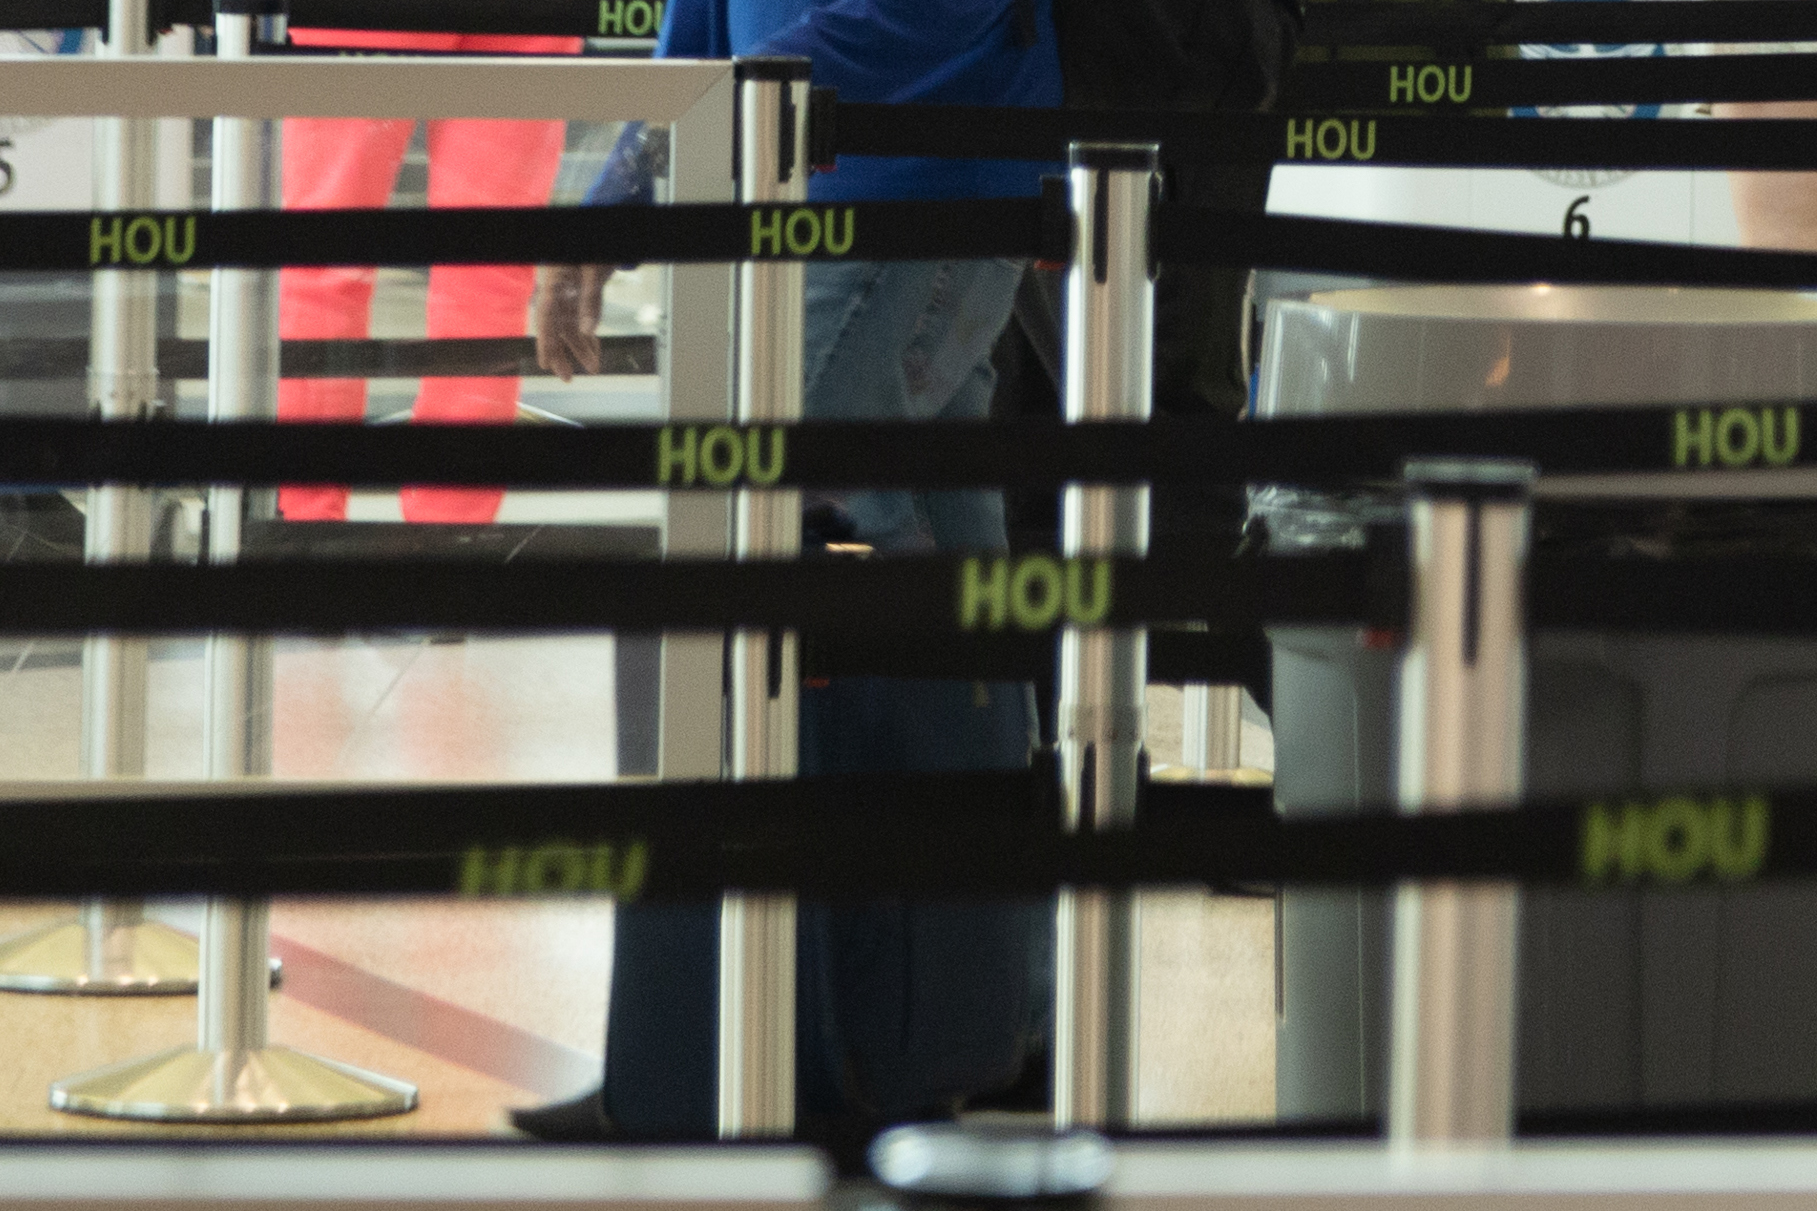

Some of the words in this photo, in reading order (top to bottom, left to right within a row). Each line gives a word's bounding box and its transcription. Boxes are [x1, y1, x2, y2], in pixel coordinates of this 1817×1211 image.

[1389, 64, 1472, 103] HOU
[1286, 118, 1376, 160] HOU
[90, 216, 196, 264] HOU
[751, 208, 855, 255] HOU
[658, 426, 785, 485] HOU
[1673, 407, 1799, 466] HOU
[961, 556, 1111, 629] HOU
[1582, 797, 1768, 879] HOU
